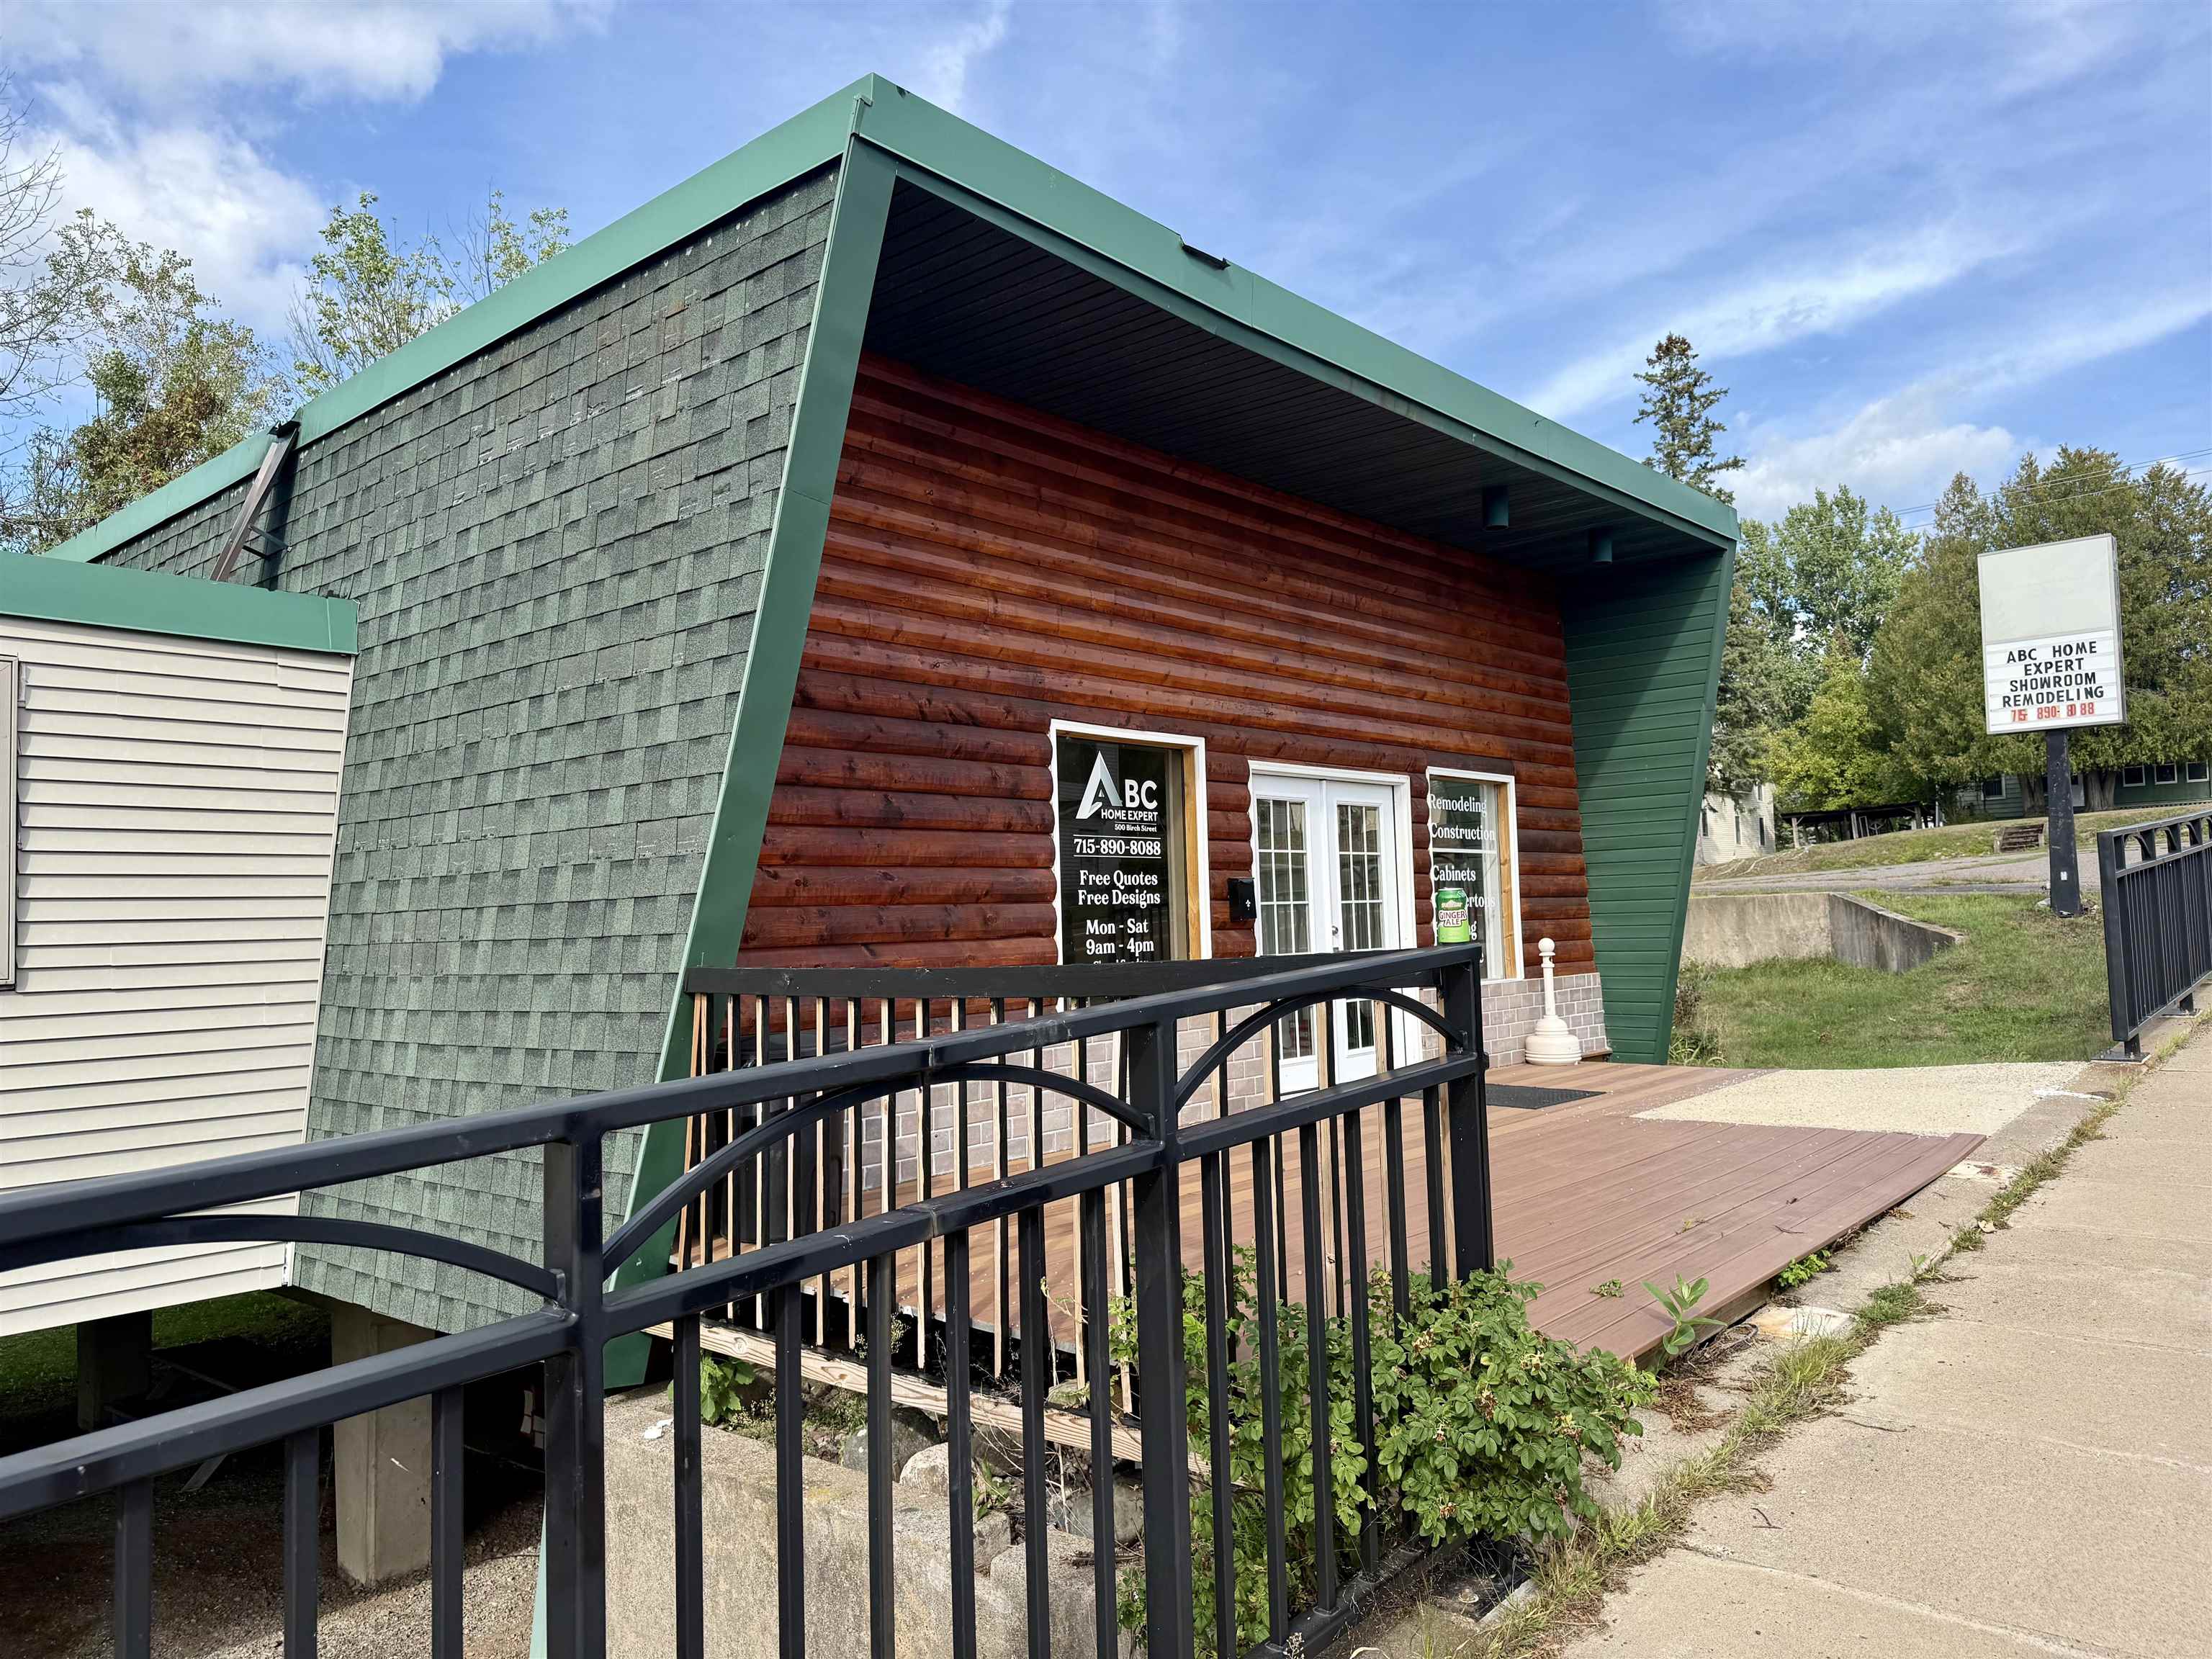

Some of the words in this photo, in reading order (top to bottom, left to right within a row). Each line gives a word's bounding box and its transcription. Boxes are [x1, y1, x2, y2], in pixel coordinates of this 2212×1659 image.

[2007, 648, 2037, 664] ABC
[2052, 641, 2097, 658] HOME
[2024, 657, 2085, 676] EXPERT
[2010, 672, 2096, 693] SHOWROOM
[2002, 685, 2104, 708] REMODELING
[1075, 750, 1158, 819] ABC
[1429, 793, 1488, 818] Remodeling
[1101, 809, 1126, 820] HOME
[1128, 810, 1158, 822] EXPERT
[1431, 822, 1496, 841] Construction
[1074, 838, 1161, 855] 715-890-8088
[1080, 870, 1111, 886] Free
[1113, 870, 1159, 890] Quotes
[1433, 865, 1476, 882] Cabinets
[1078, 889, 1109, 905] Free
[1112, 889, 1161, 909] Designs
[1439, 911, 1467, 920] GINGER
[1086, 919, 1116, 935] Mon
[1127, 918, 1149, 934] Sat
[1086, 939, 1116, 956] 9am
[1126, 938, 1154, 957] 4pm
